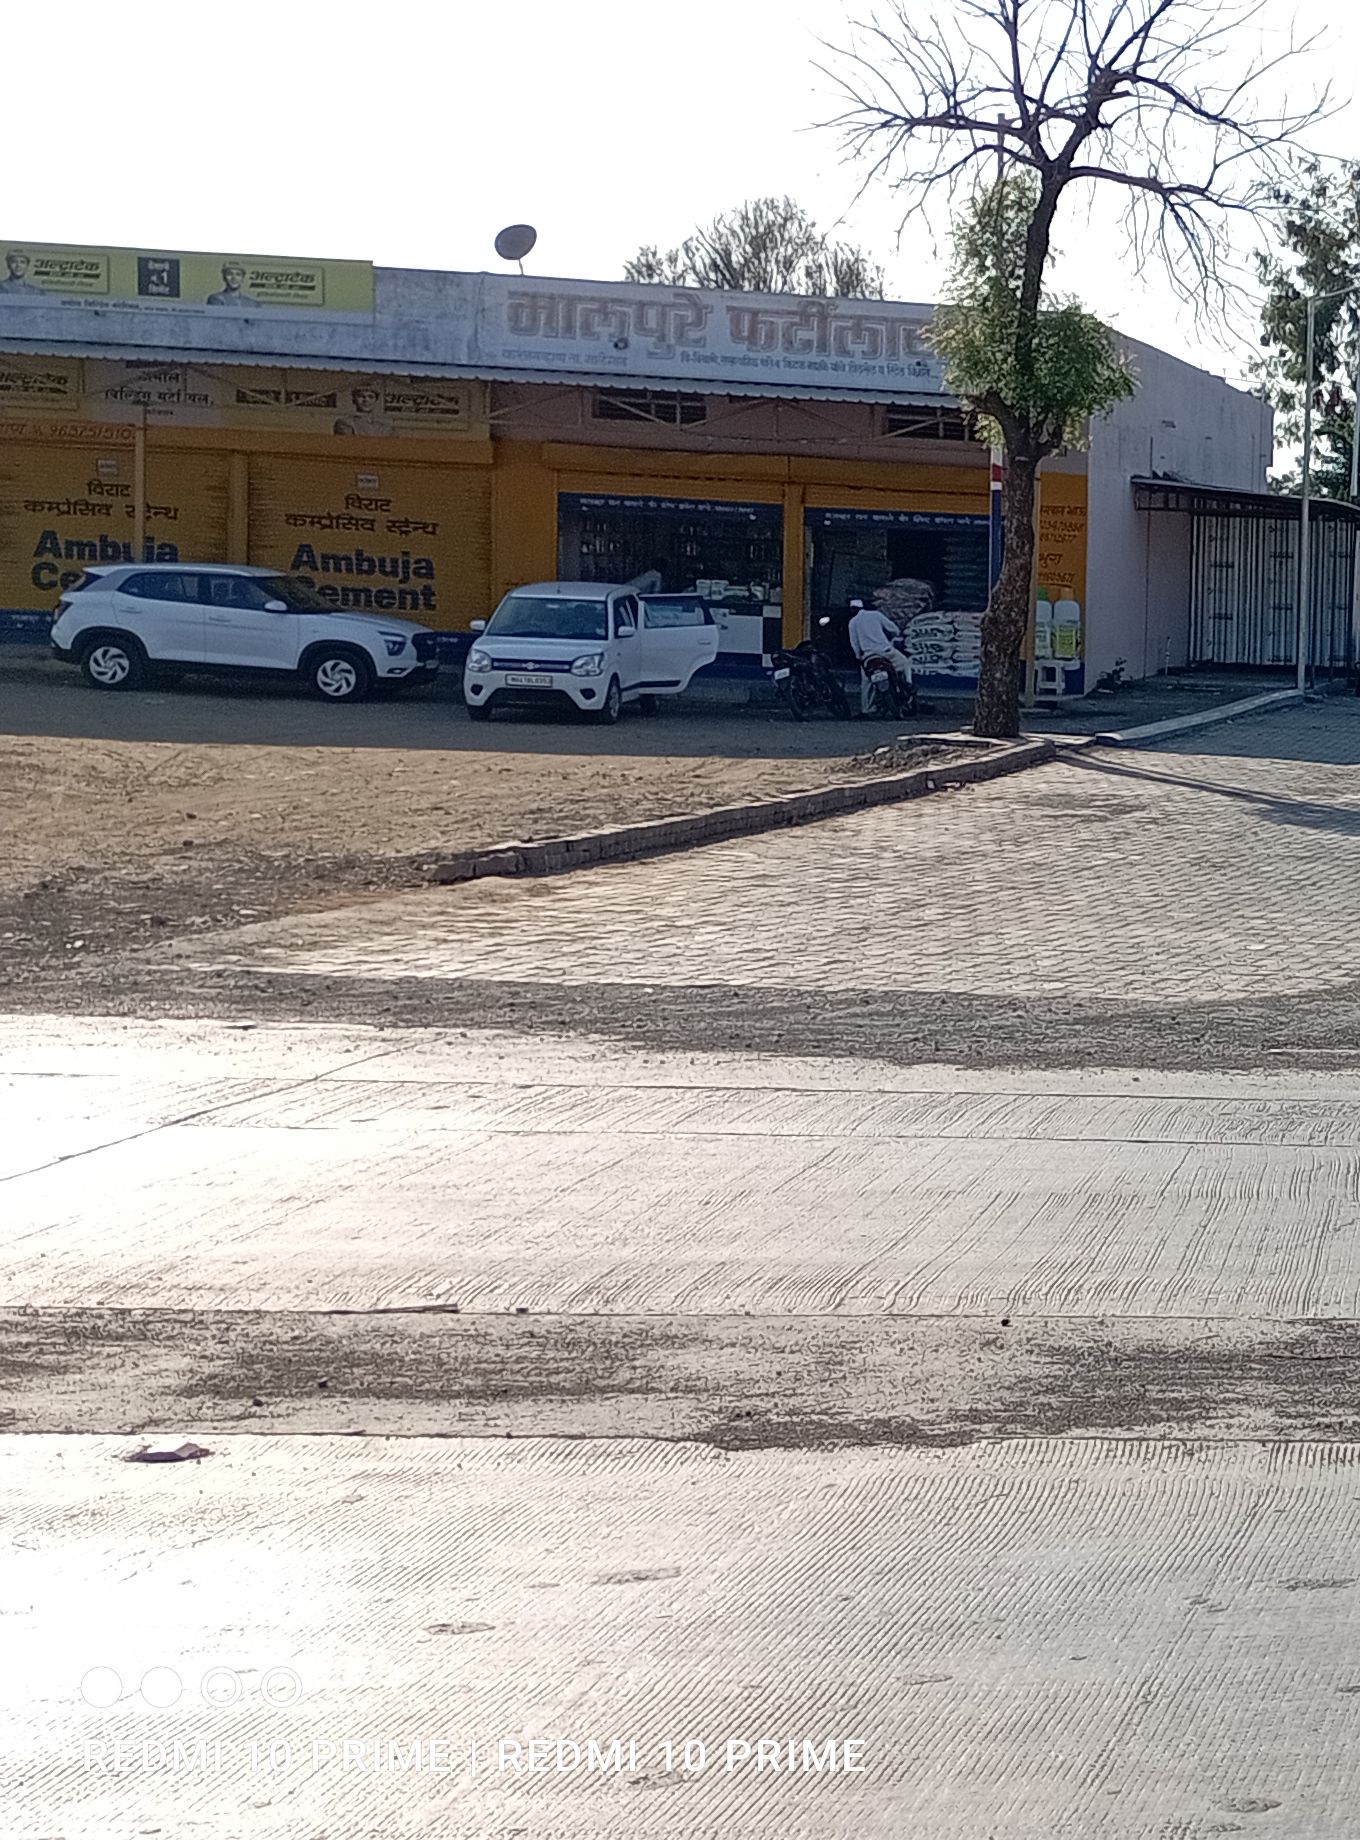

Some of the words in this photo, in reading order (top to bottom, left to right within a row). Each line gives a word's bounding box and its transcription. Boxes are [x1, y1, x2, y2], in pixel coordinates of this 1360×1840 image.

[508, 290, 713, 359] मालपुरे
[87, 479, 131, 497] विराट
[344, 494, 393, 512] विराट
[291, 543, 436, 584] Ambuja
